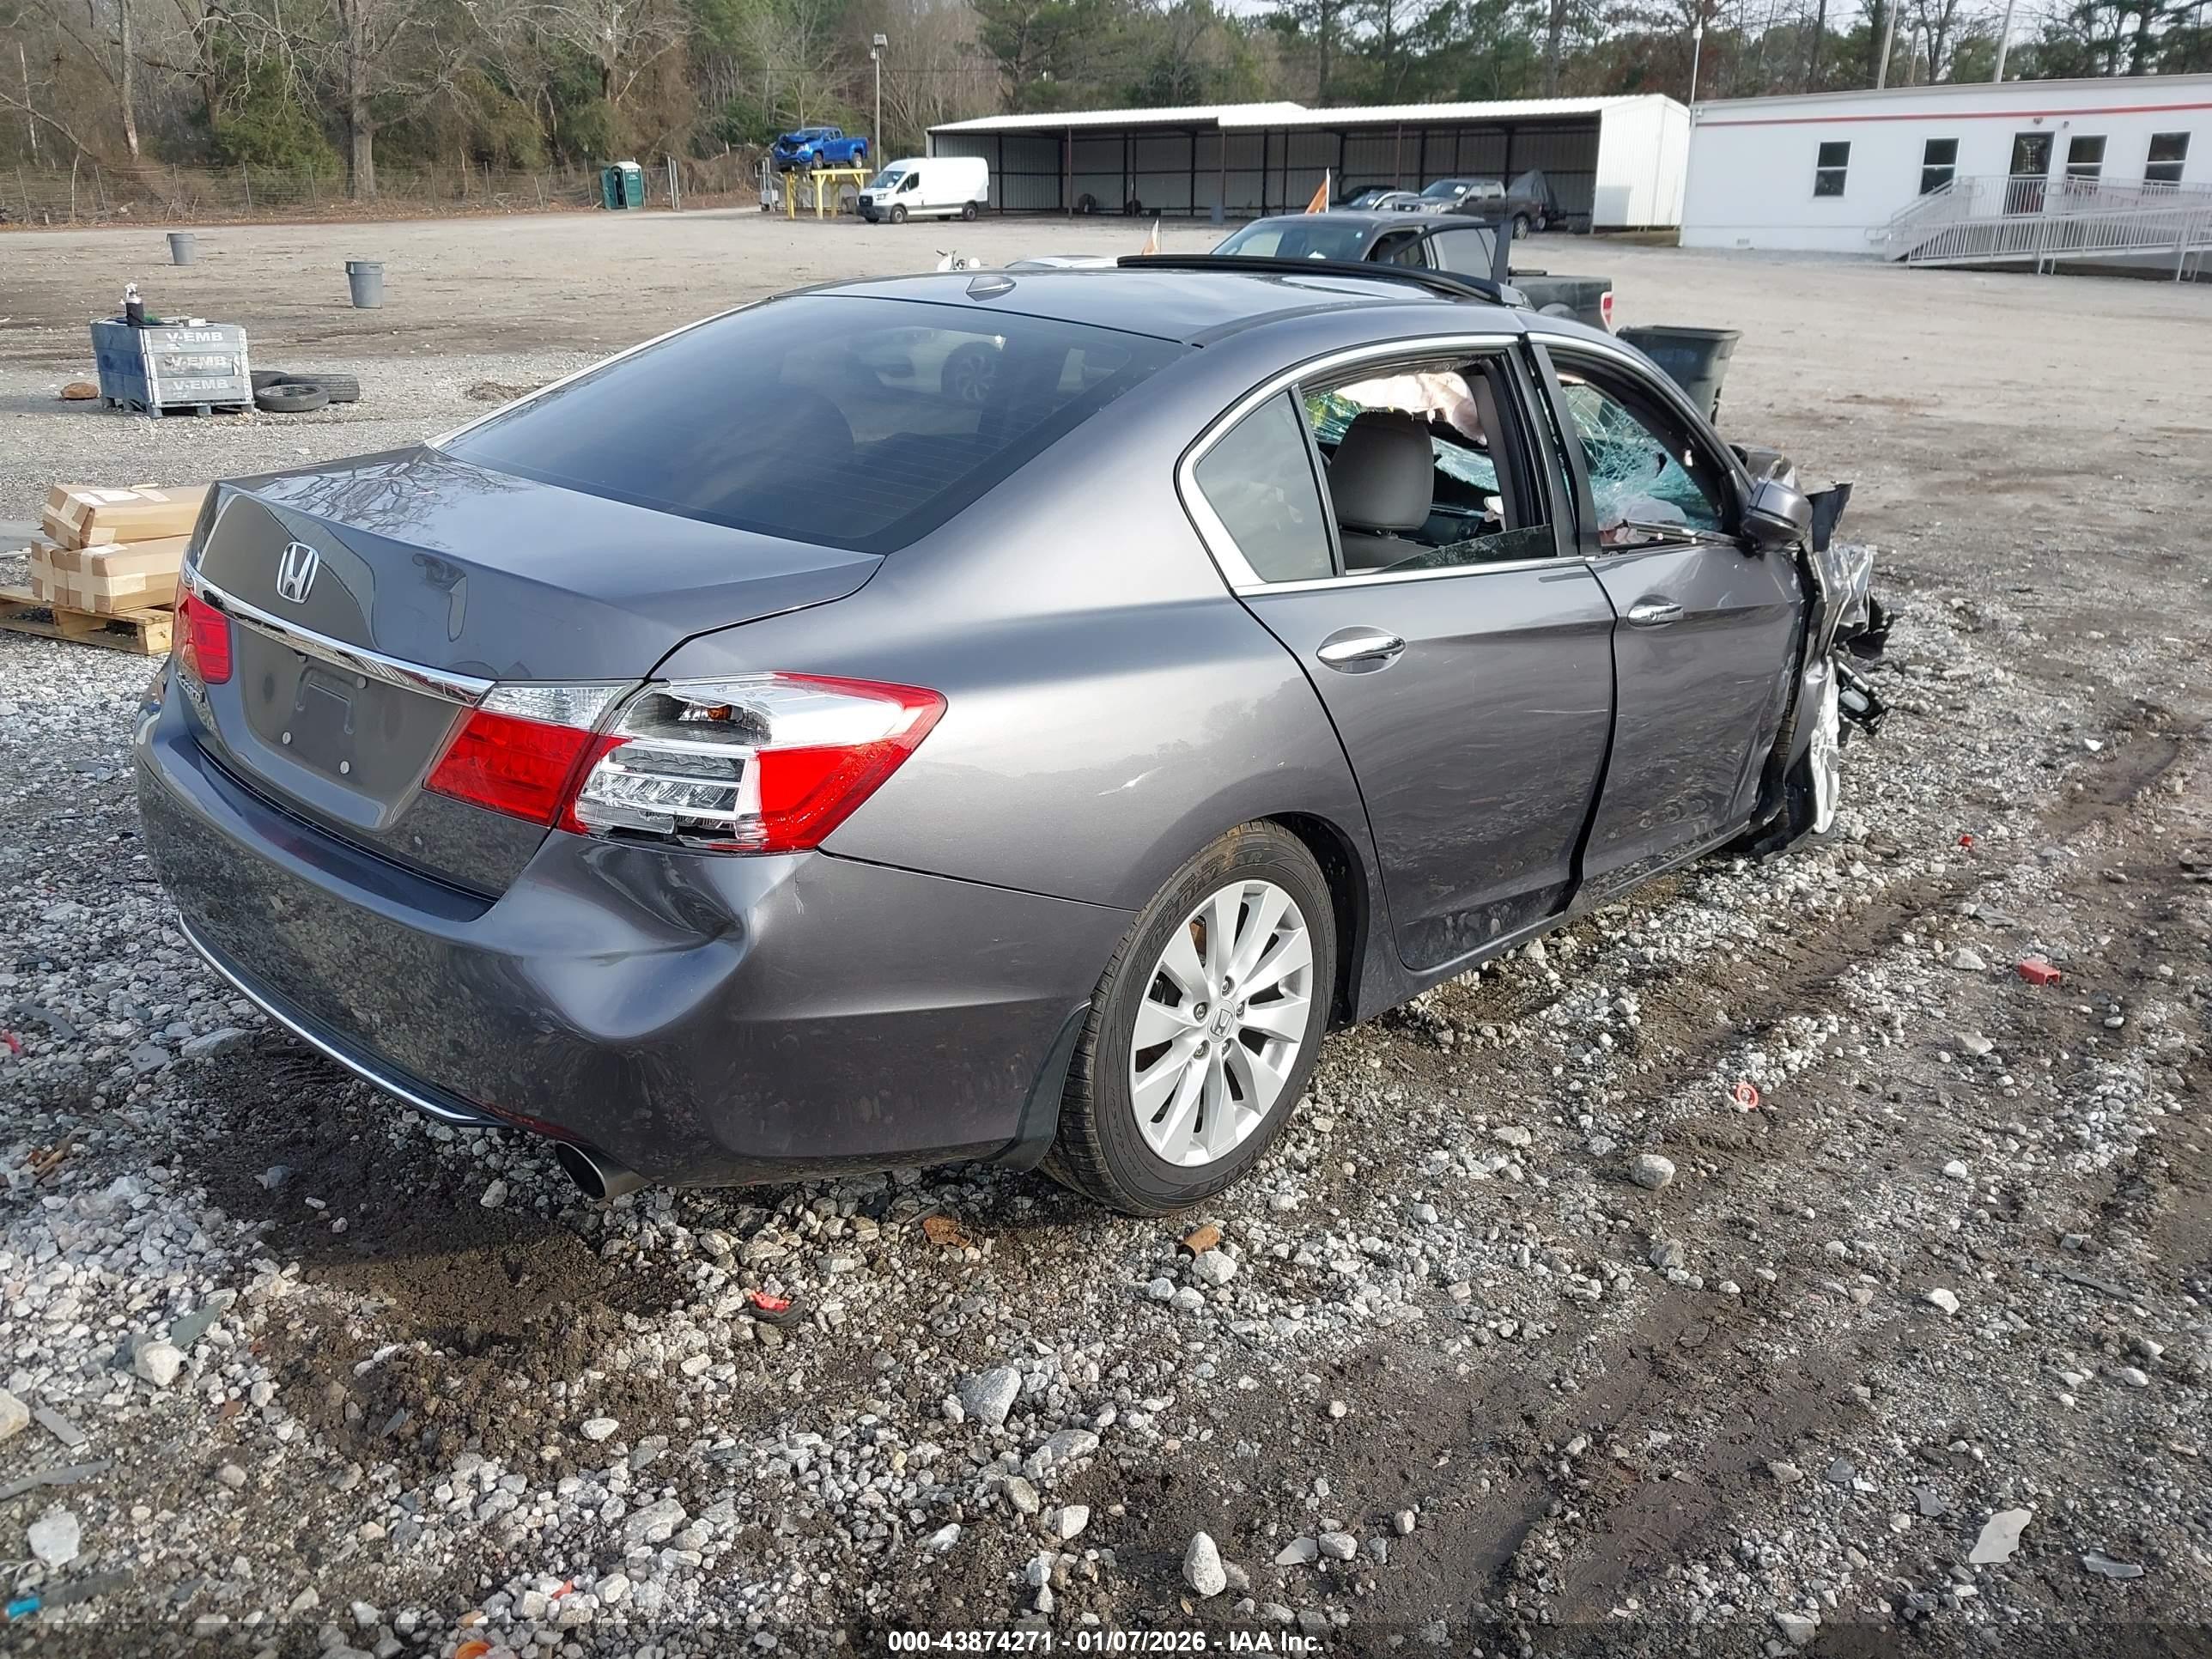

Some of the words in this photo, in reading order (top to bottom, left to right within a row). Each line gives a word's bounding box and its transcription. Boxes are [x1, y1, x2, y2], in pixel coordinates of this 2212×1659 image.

[166, 331, 223, 342] V-EMB
[172, 356, 228, 368] V-EMB
[173, 380, 228, 390] V-EMB
